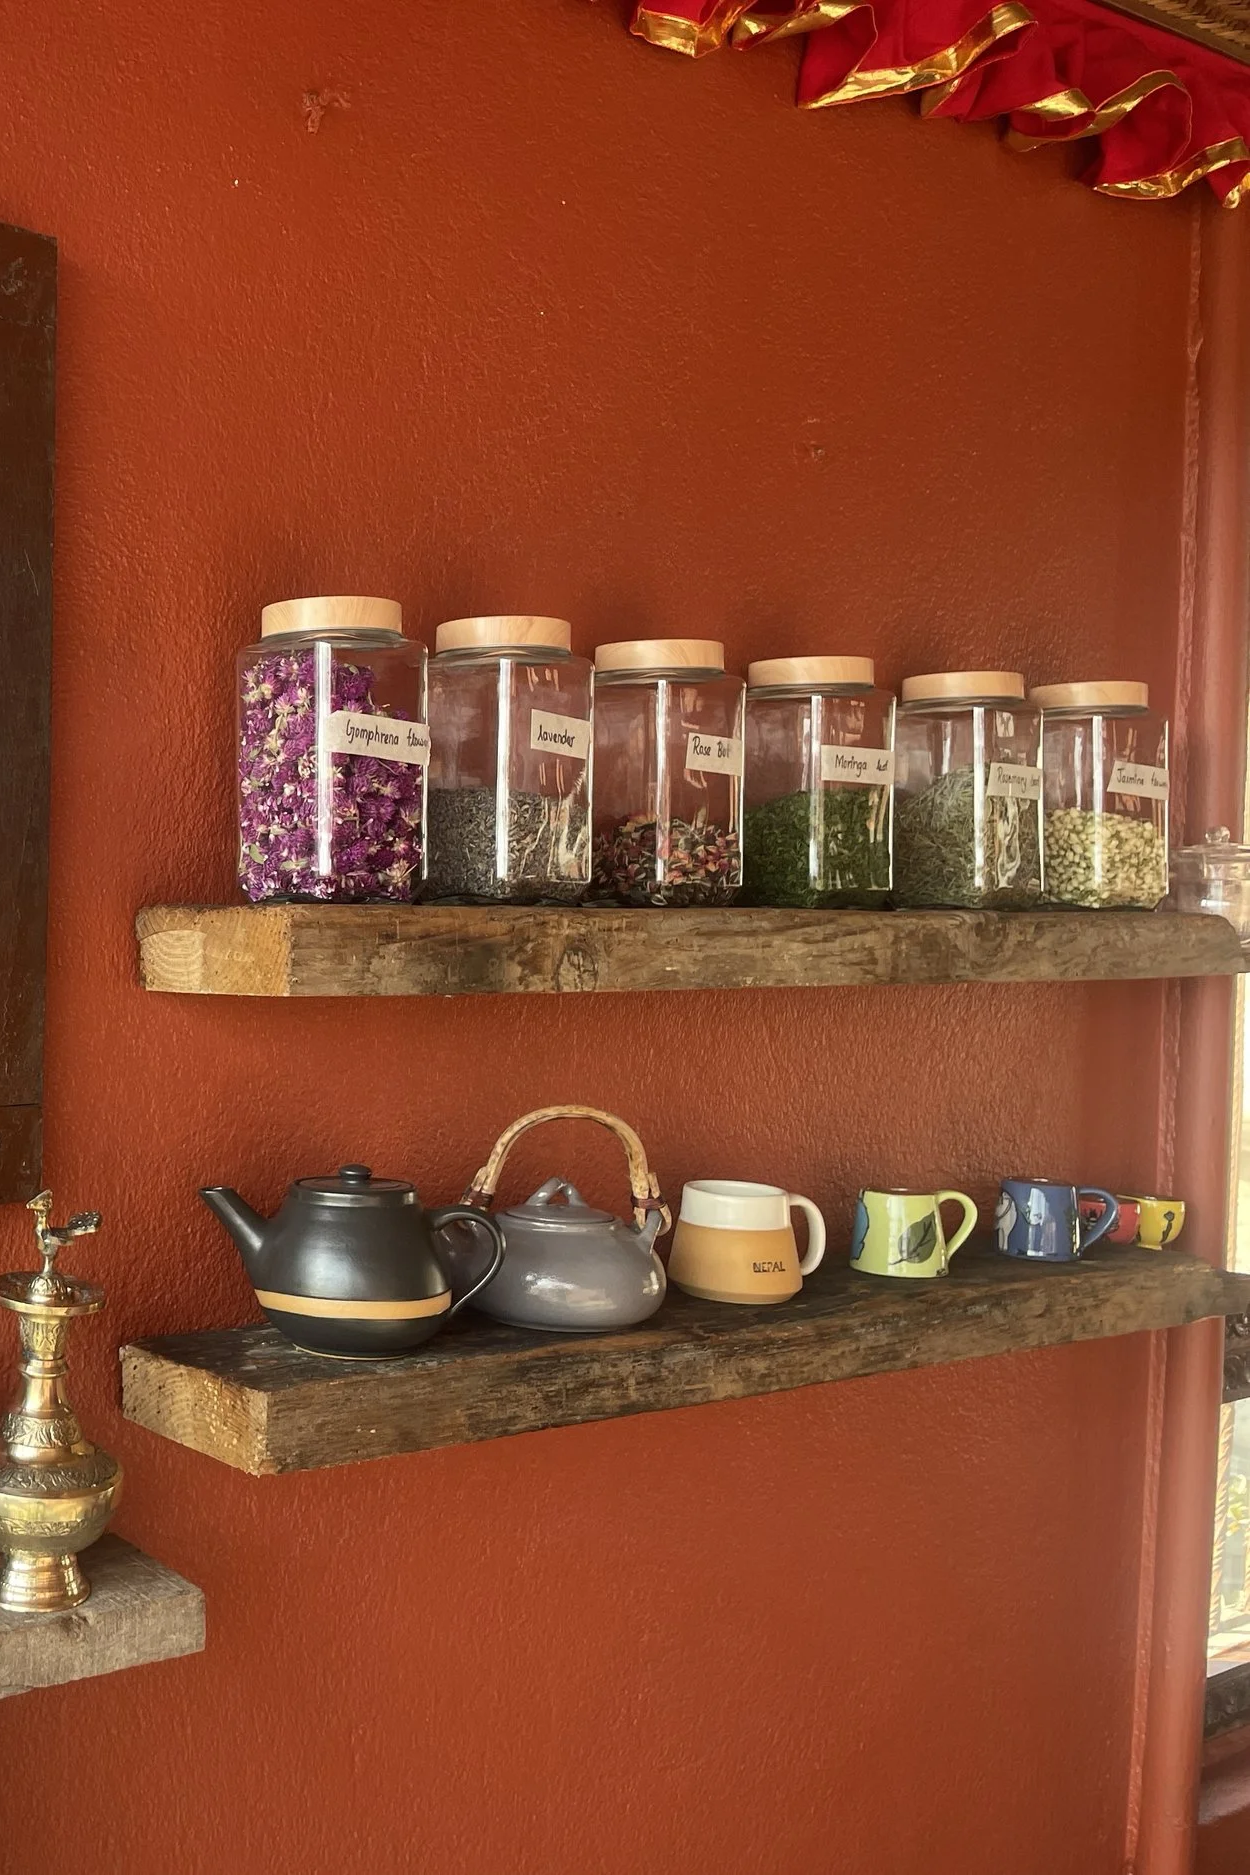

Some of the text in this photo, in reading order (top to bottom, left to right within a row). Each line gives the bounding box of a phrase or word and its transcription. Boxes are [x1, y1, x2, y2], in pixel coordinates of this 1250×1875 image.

[346, 718, 399, 747] Gomphrena
[692, 735, 712, 757] Rose
[834, 754, 868, 778] Moringa
[752, 1261, 786, 1273] NEPAL
